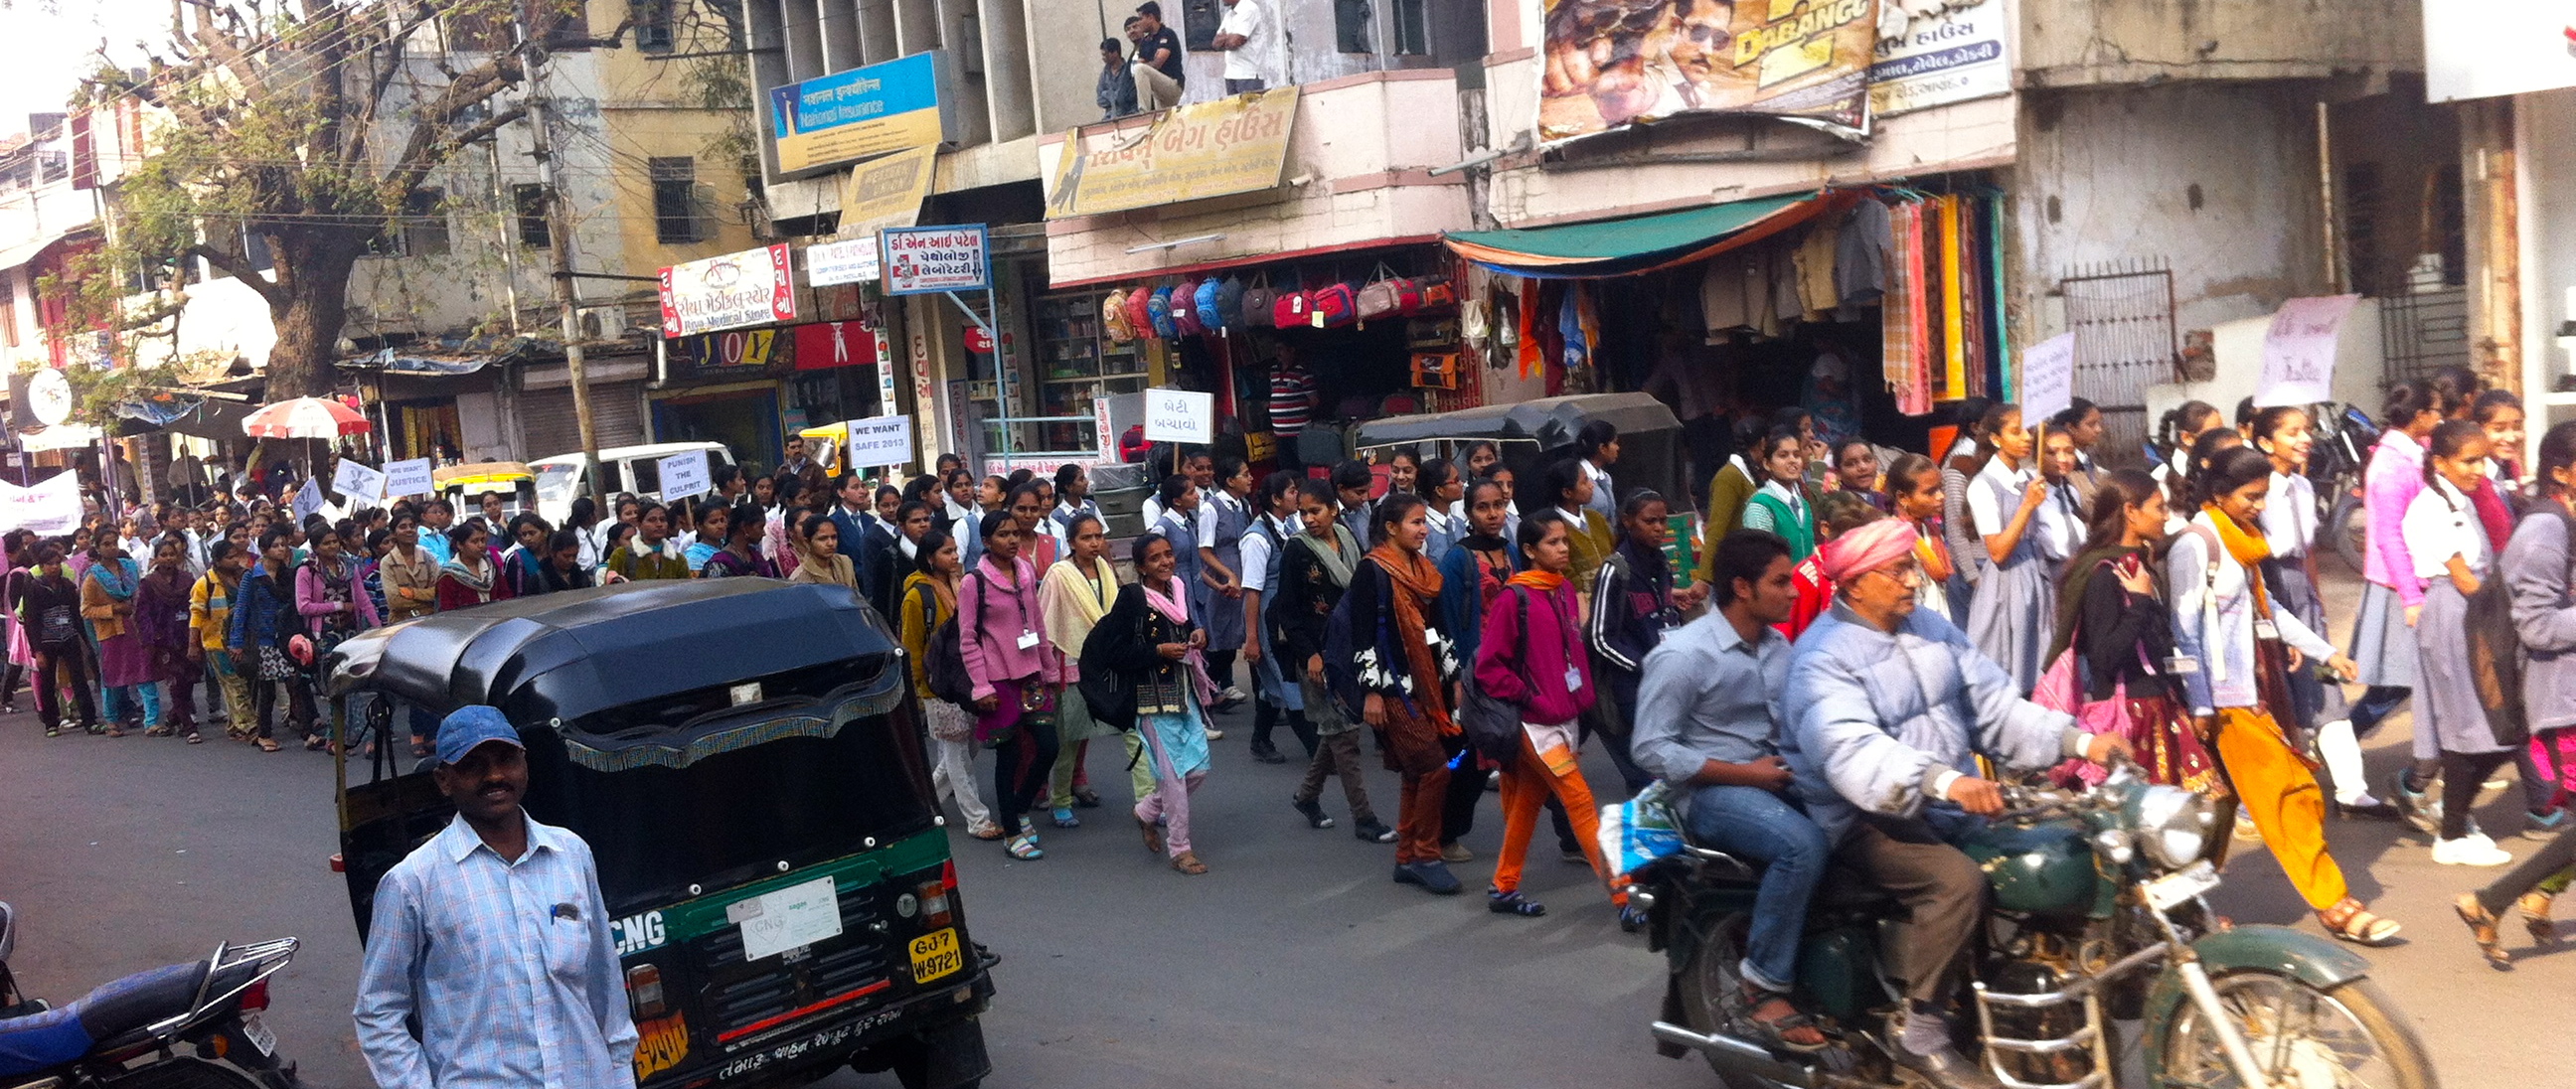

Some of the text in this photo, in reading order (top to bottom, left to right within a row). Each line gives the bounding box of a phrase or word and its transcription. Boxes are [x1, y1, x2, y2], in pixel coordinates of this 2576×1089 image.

[1916, 21, 1975, 45] હાઉસ
[799, 99, 885, 128] National Insurance
[1164, 117, 1205, 153] બેગ
[1214, 105, 1283, 152] હાઉસ
[953, 232, 978, 247] પટેલ
[920, 250, 969, 262] પેથોલોજી
[920, 262, 971, 275] લેબોરેટરી
[707, 310, 742, 329] Medical
[744, 308, 771, 323] Store
[700, 332, 771, 365] JOY
[1164, 398, 1189, 413] બેટી
[856, 424, 900, 435] WE WANT
[855, 439, 904, 450] SAFE 2013
[668, 456, 696, 468] PUNISH
[390, 476, 427, 487] JUSTICE
[676, 470, 691, 479] THE
[670, 481, 701, 494] CULPRIT
[609, 910, 666, 956] CNG
